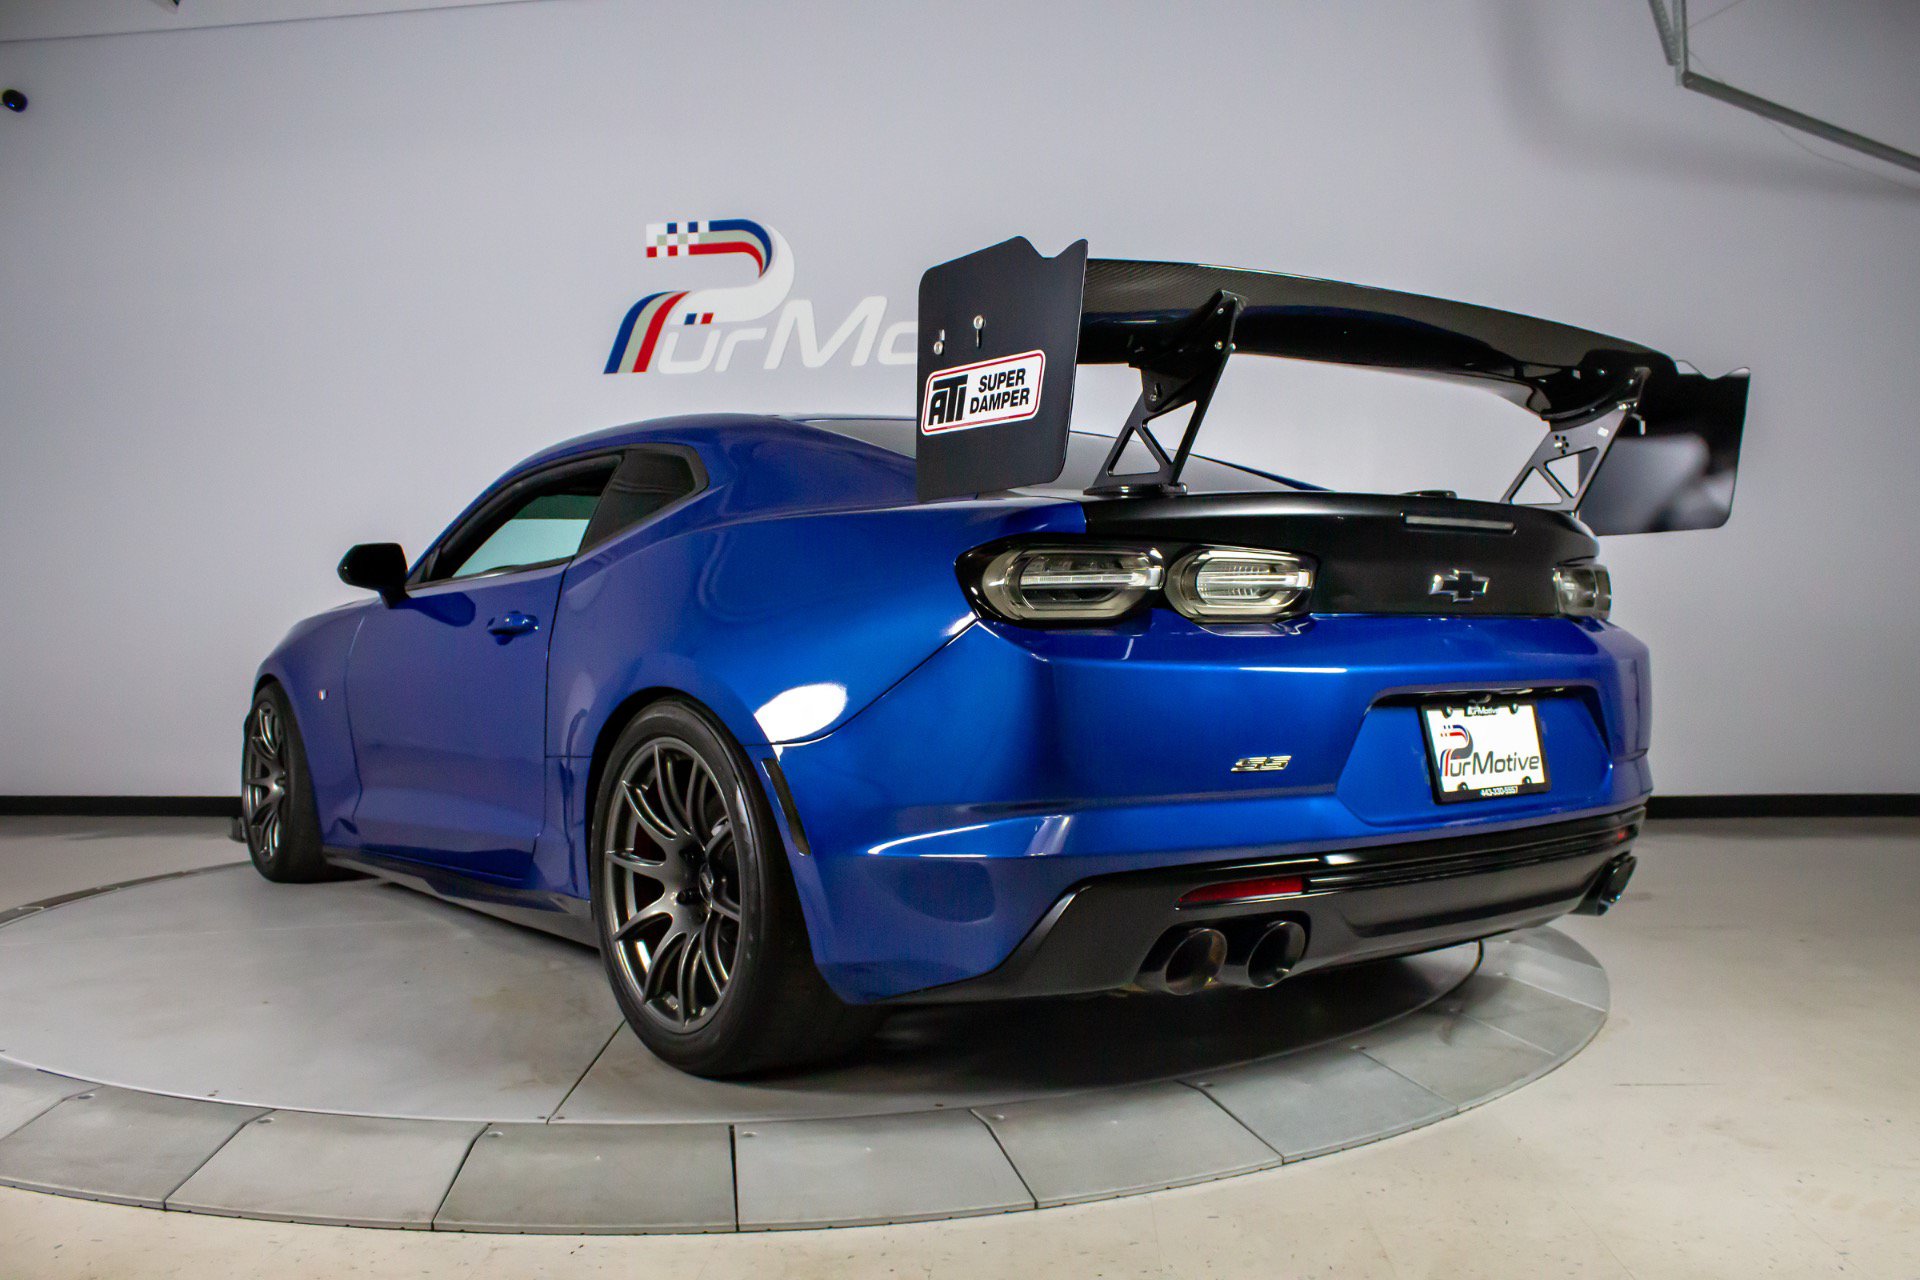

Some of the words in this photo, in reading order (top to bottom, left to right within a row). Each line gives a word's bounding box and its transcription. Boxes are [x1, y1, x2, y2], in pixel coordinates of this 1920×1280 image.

[604, 219, 918, 374] PurMo
[928, 374, 968, 426] ATI
[978, 368, 1026, 393] SUPER
[969, 388, 1030, 414] DAMPER
[1230, 755, 1292, 772] SS
[1440, 724, 1540, 777] PurMotive
